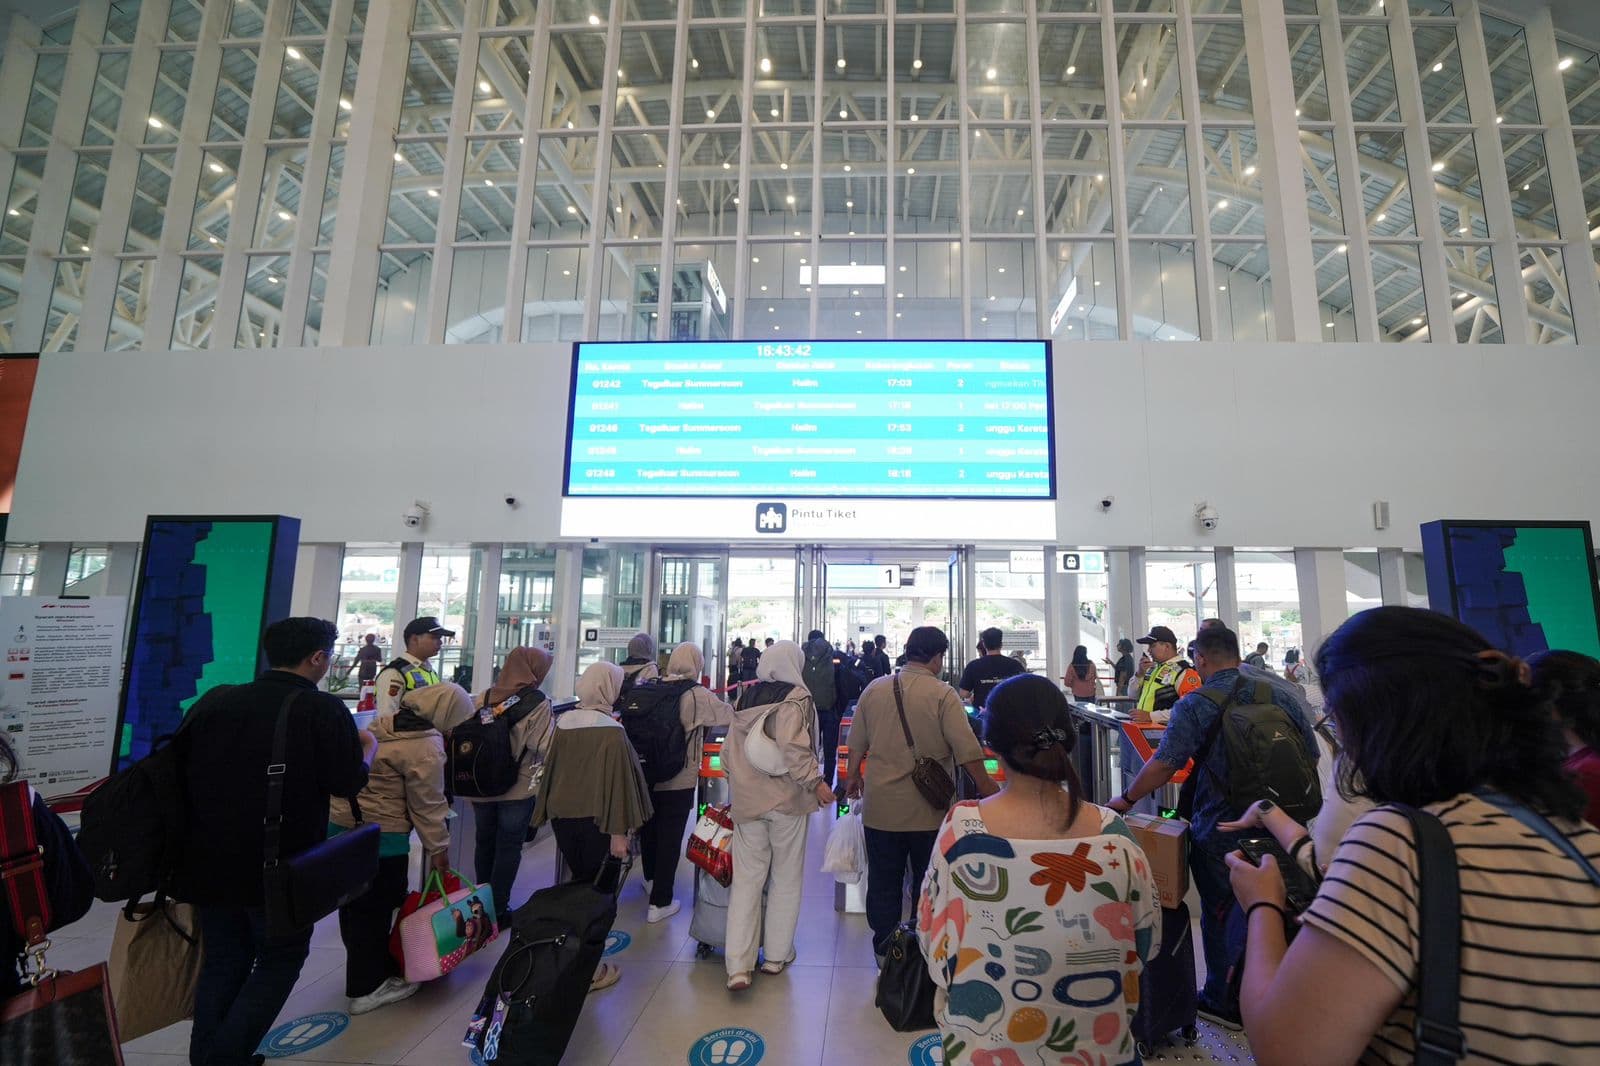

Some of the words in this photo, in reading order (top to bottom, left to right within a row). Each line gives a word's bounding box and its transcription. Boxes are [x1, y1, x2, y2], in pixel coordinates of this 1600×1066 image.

[757, 344, 812, 357] 16:43:42
[791, 509, 823, 519] Pintu
[825, 509, 857, 519] Tiket
[885, 569, 893, 583] 1
[703, 1029, 734, 1042] Berdiri
[916, 1034, 943, 1049] Berdir
